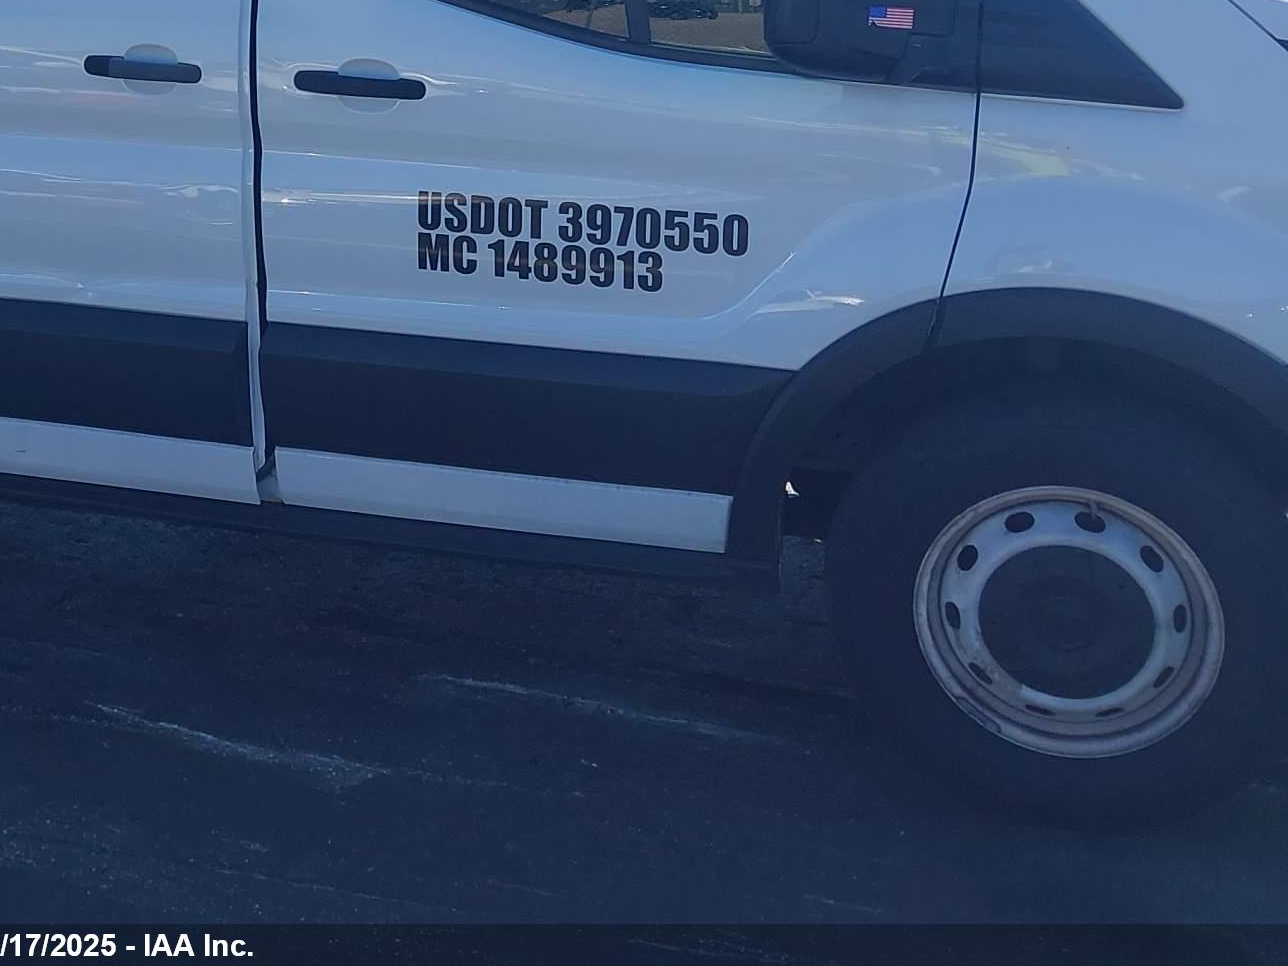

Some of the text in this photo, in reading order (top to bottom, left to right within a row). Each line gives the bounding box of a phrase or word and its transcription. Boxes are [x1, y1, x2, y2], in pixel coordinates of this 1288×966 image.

[417, 190, 749, 257] USDOT 3970550
[417, 232, 663, 293] MC 1489913
